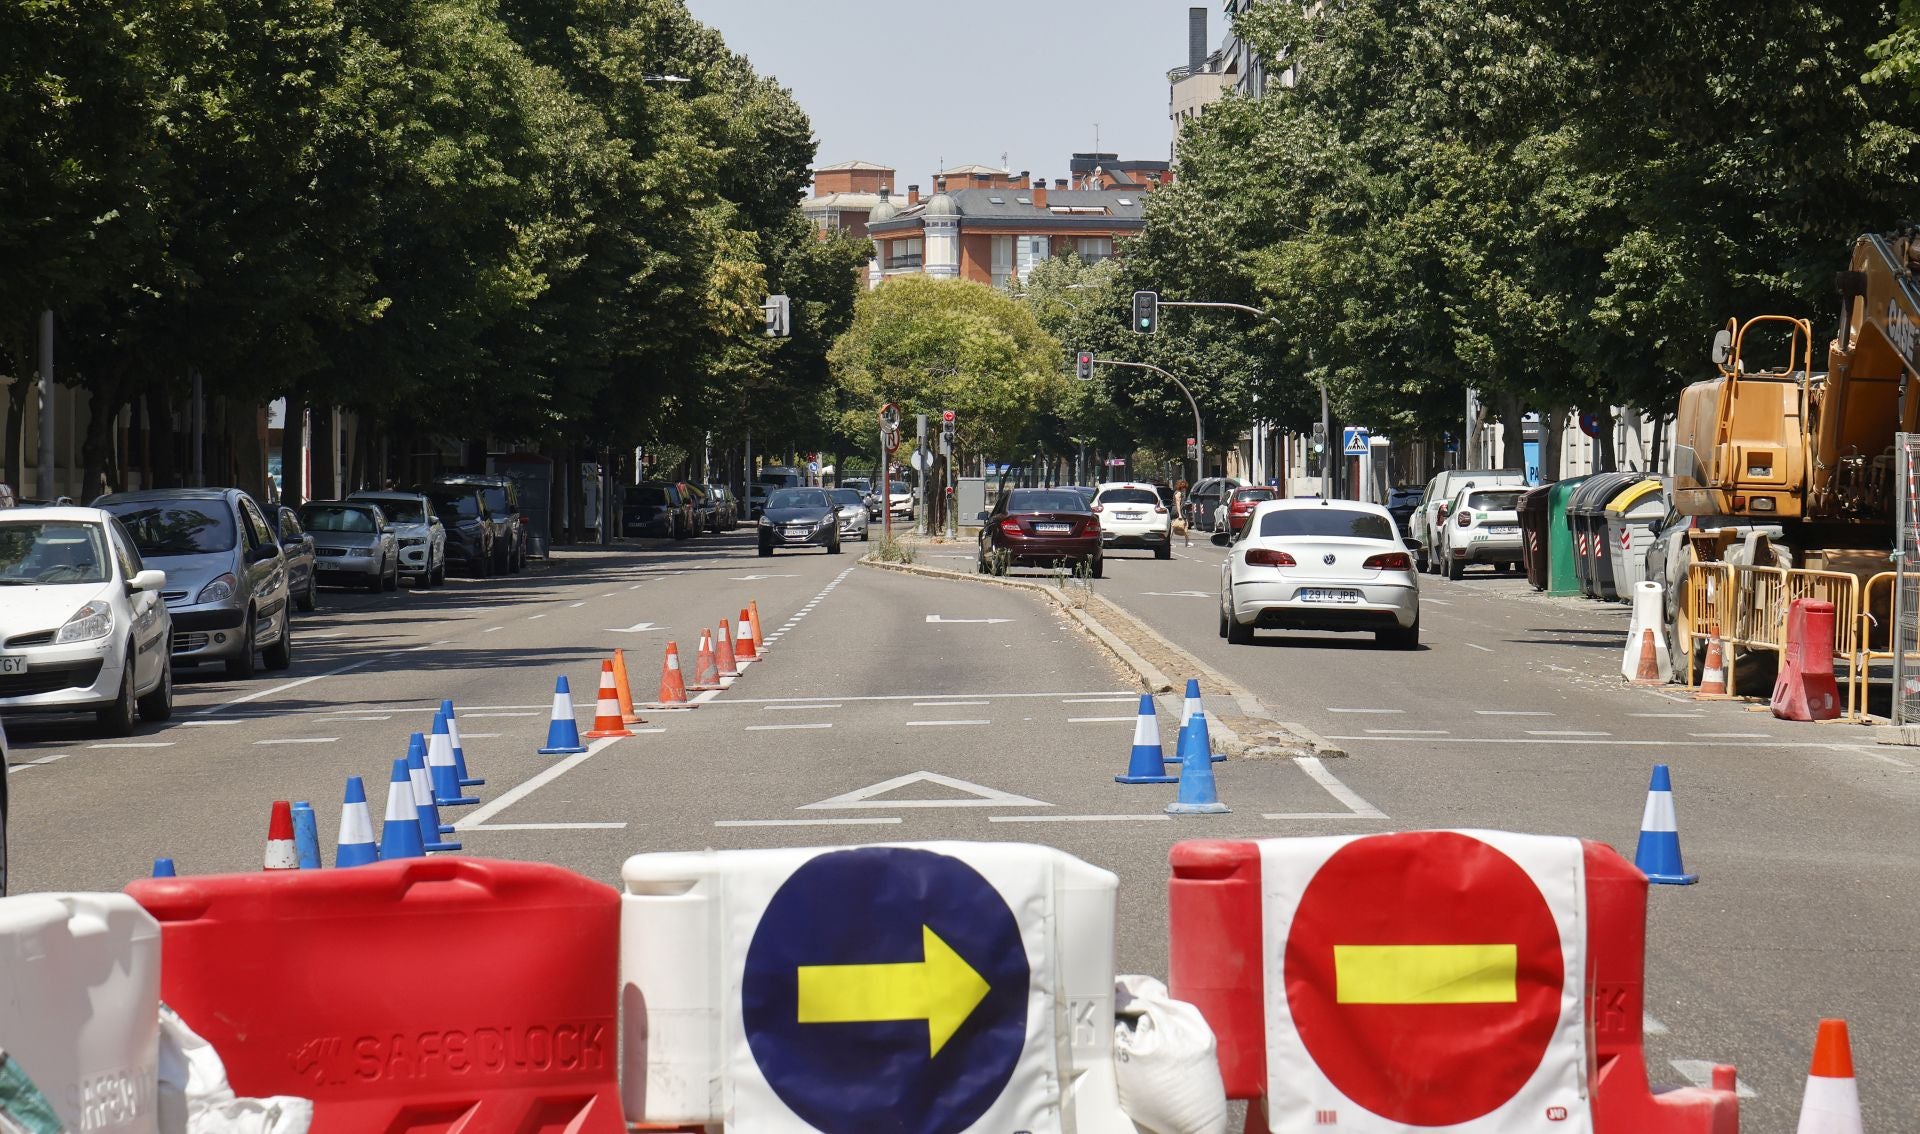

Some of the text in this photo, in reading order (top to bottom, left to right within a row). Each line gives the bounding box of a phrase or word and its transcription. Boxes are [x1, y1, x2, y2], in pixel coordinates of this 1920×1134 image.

[1889, 299, 1914, 362] CASE
[1308, 590, 1356, 600] 2914 JPR
